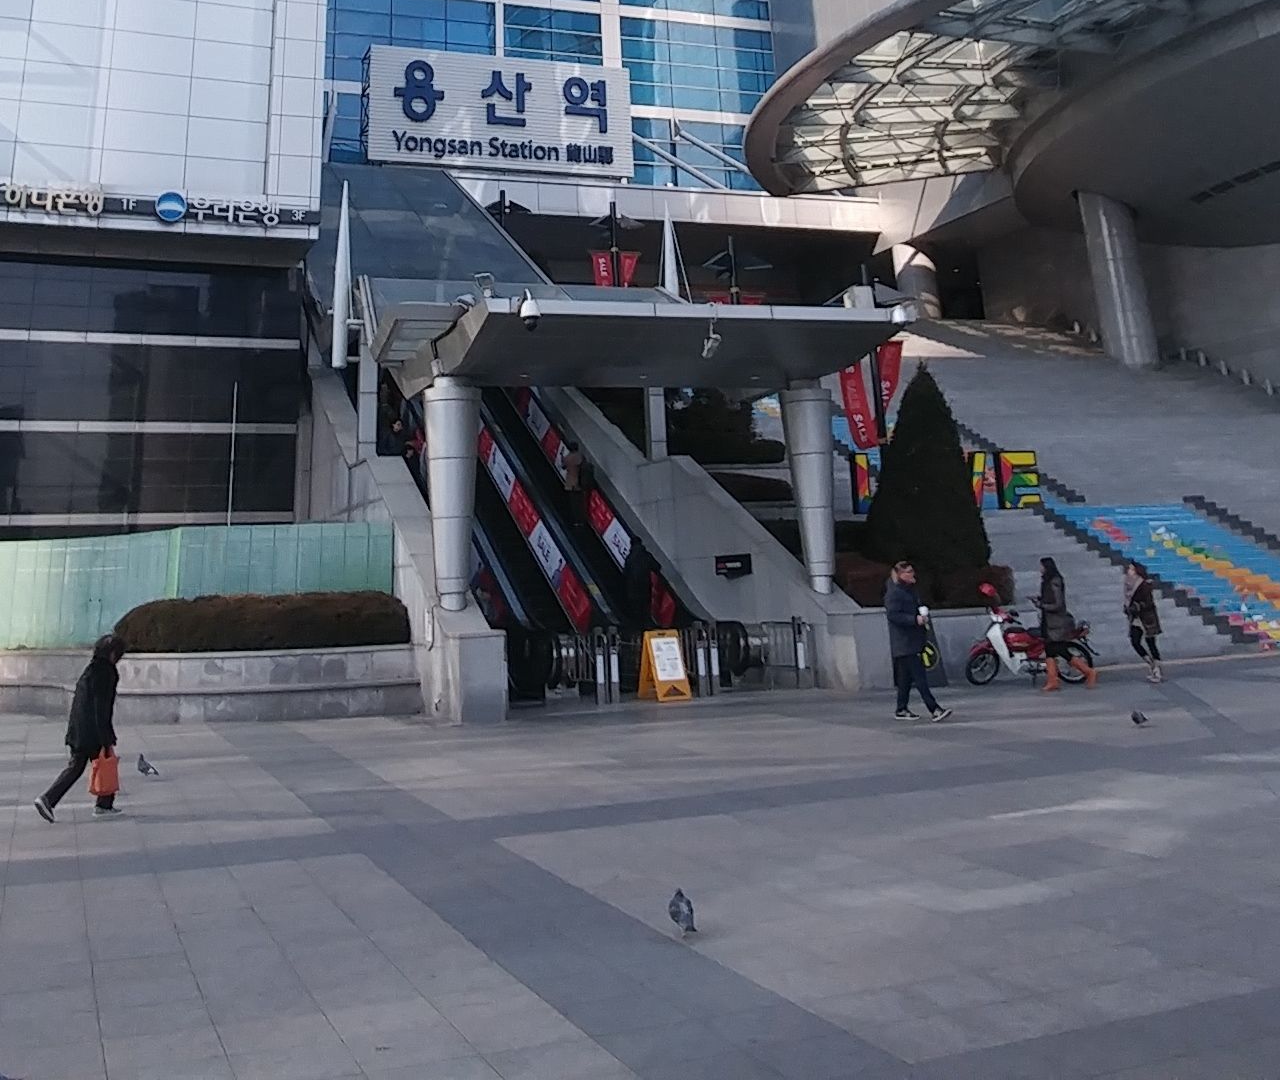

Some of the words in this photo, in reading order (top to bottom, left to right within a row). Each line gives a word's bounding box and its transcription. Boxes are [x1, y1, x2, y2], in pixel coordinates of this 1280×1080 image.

[392, 129, 483, 159] Yongsan
[488, 136, 560, 162] Station
[5, 182, 105, 217] 하나은행
[121, 197, 137, 211] 1F
[188, 197, 280, 227] 우리은행
[291, 208, 306, 222] 3F
